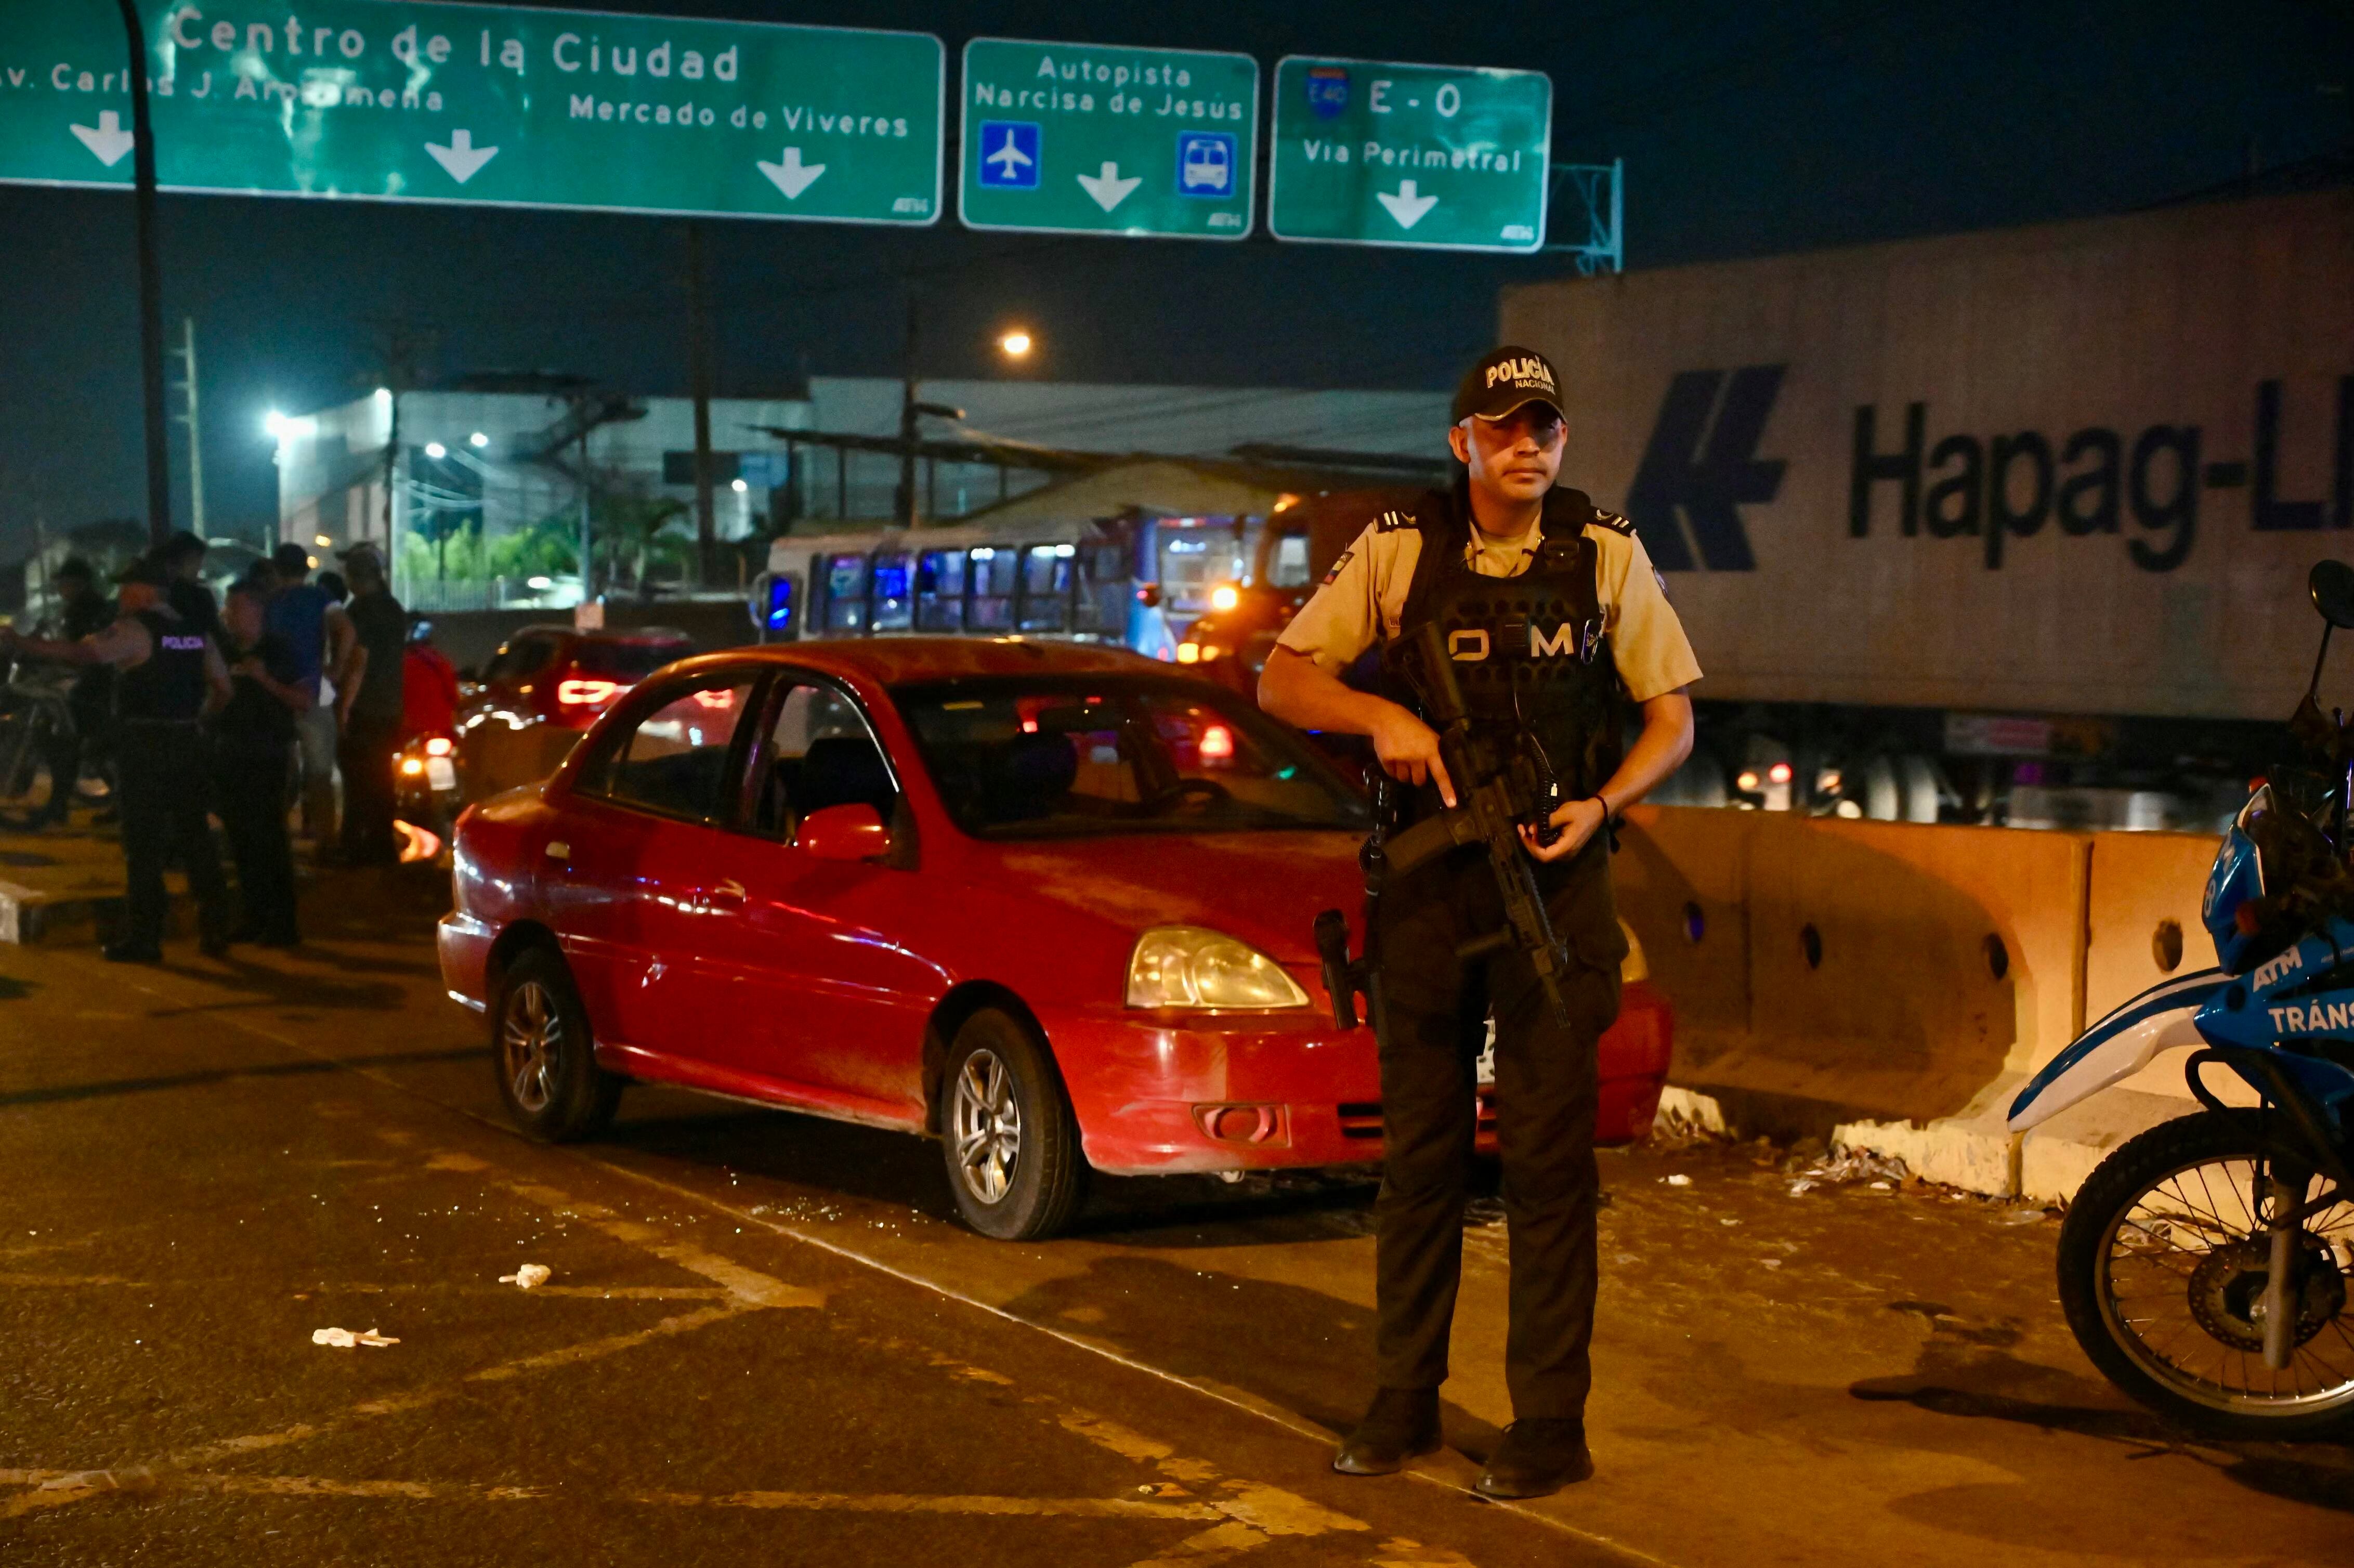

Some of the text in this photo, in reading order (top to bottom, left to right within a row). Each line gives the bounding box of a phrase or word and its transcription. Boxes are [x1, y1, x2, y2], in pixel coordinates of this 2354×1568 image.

[173, 8, 738, 82] Centro de la Ciudad
[0, 67, 34, 88] v.
[1037, 55, 1191, 88] Autopista
[975, 82, 1243, 120] Narcisa de Jesús
[1369, 80, 1392, 113] E
[569, 94, 908, 137] Mercado de Viveres
[1363, 141, 1521, 172] Perimetral
[1514, 379, 1556, 396] NACIONAL
[2253, 944, 2303, 993] ATM
